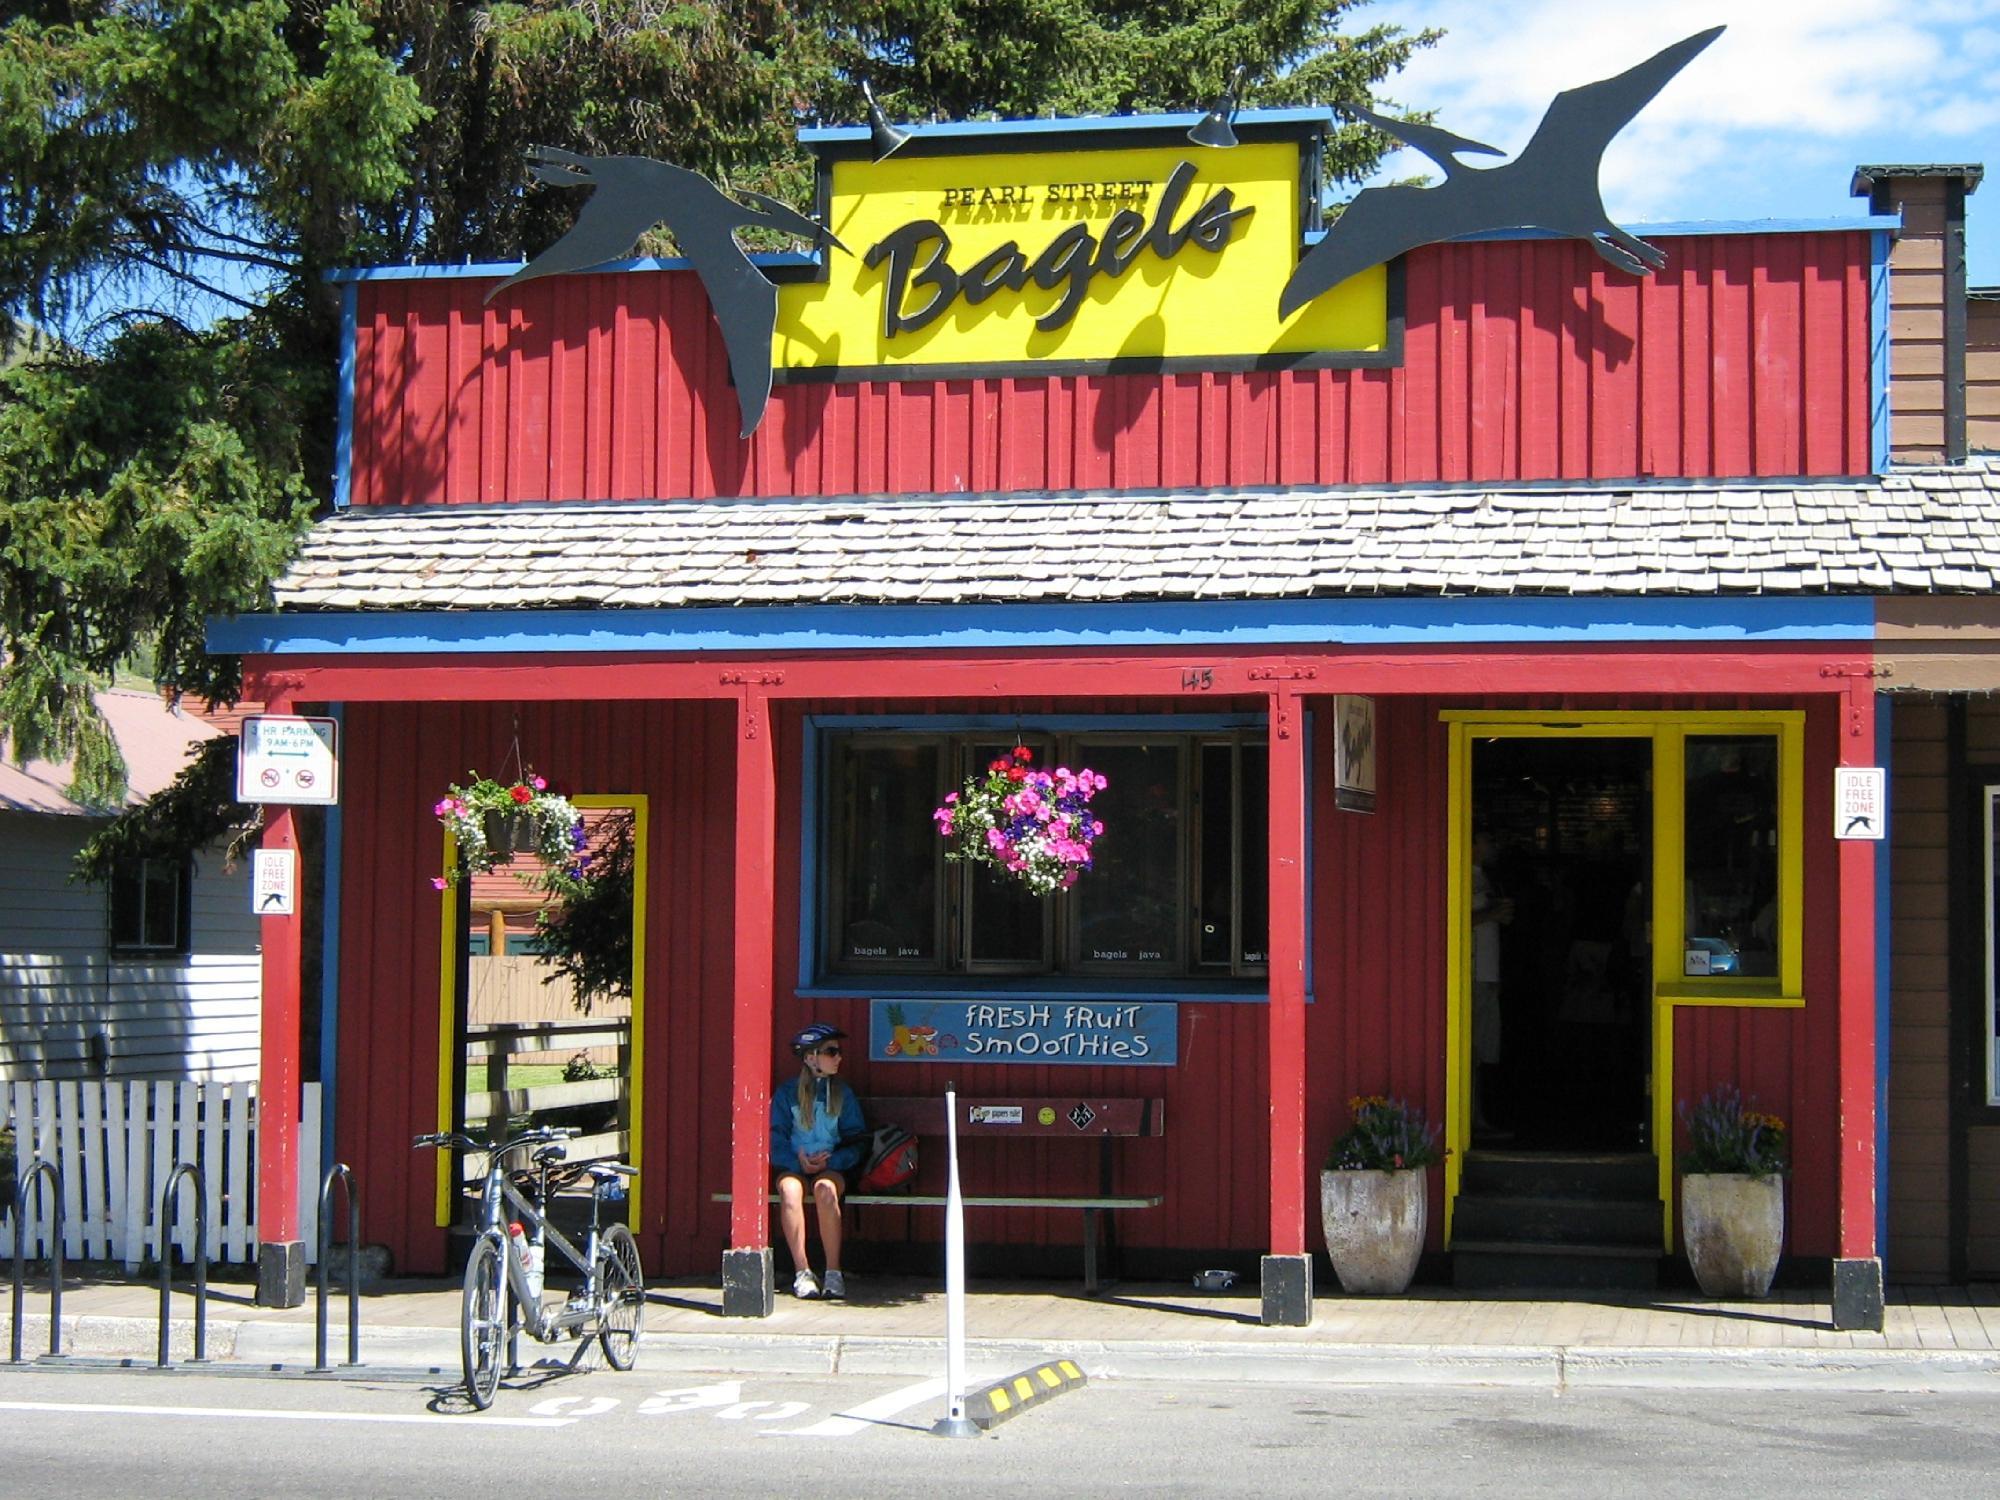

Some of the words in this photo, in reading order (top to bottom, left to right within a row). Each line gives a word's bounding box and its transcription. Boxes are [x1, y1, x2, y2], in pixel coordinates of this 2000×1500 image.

[944, 184, 1034, 207] PEARL
[1047, 180, 1153, 203] STREET
[862, 160, 1256, 339] Bagels
[1182, 670, 1214, 692] 145
[282, 726, 327, 737] PARKING
[1847, 775, 1872, 787] IDLE
[1845, 788, 1874, 800] FREE
[1845, 801, 1874, 813] ZONE
[264, 856, 285, 867] IDLE
[262, 868, 286, 879] FREE
[262, 880, 286, 891] ZONE
[853, 946, 887, 956] bagels
[897, 946, 920, 957] java
[1093, 949, 1128, 960] bagels
[1138, 949, 1161, 960] java
